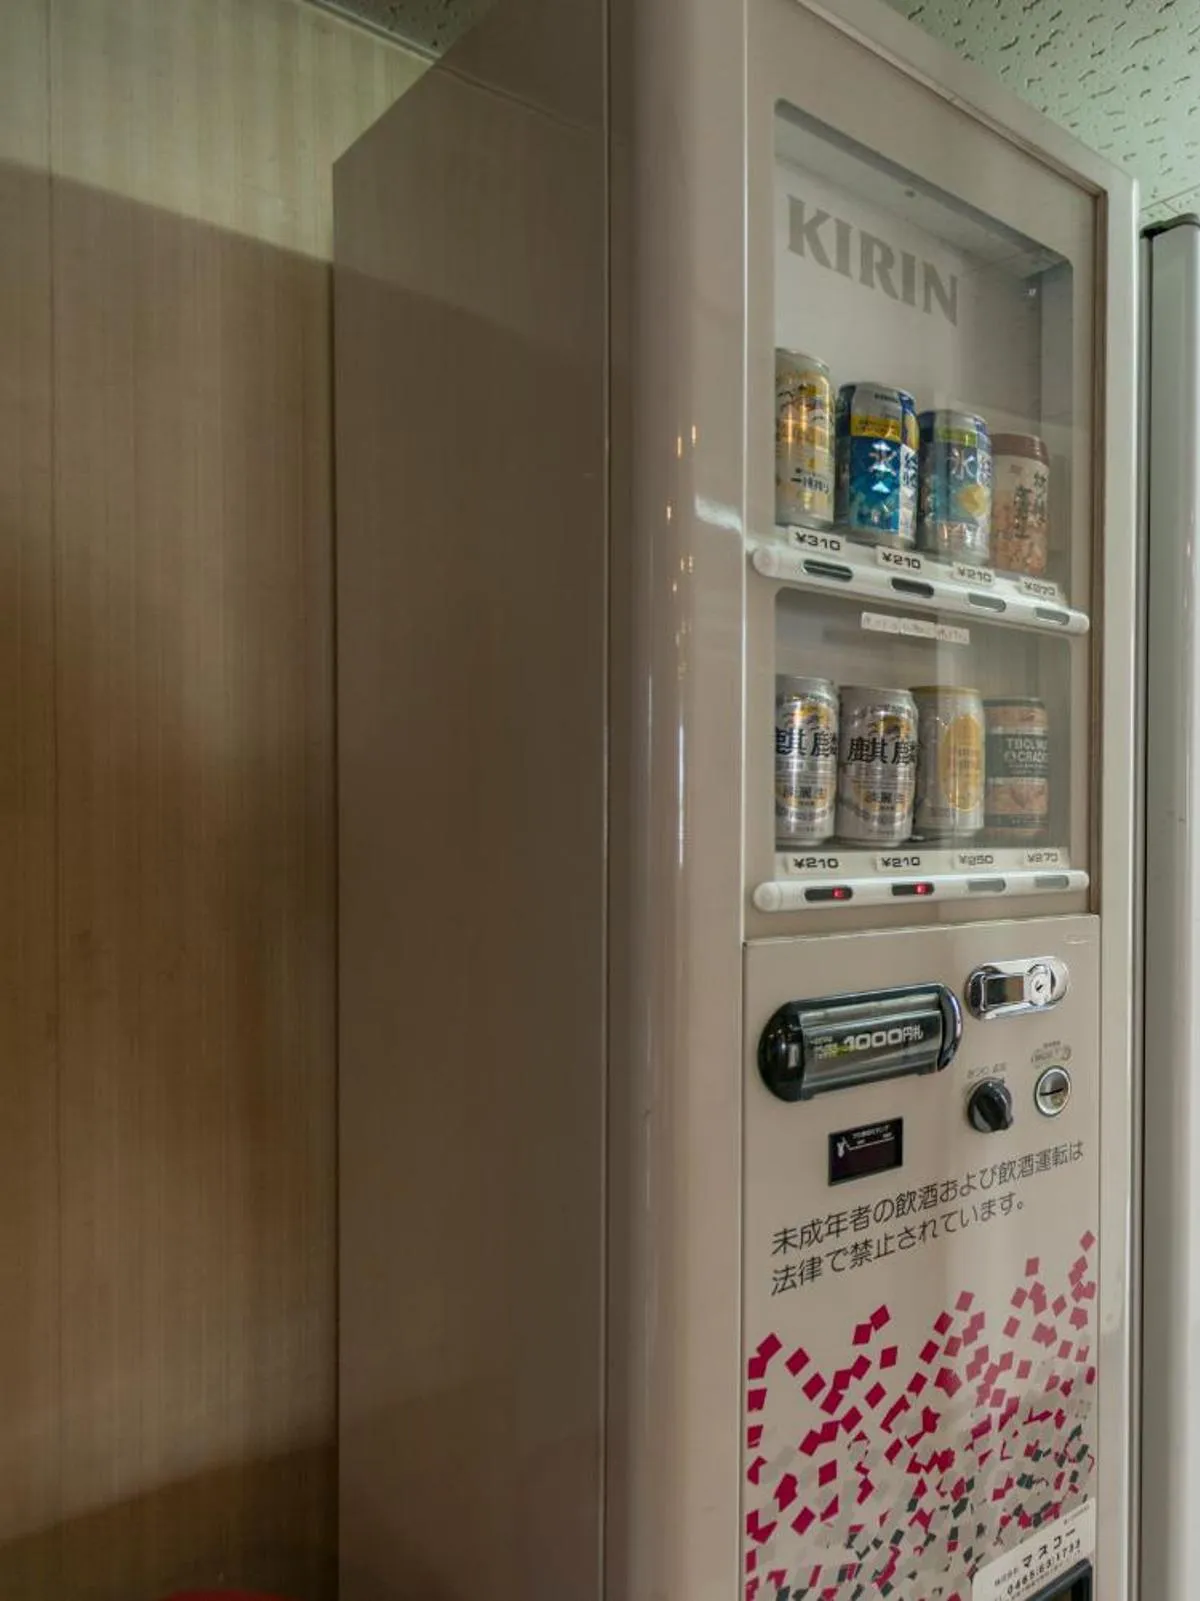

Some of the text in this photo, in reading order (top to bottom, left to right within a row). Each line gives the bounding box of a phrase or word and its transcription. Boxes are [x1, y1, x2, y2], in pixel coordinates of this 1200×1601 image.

[785, 194, 960, 327] KIRIN
[795, 530, 841, 551] ¥310
[882, 551, 921, 570] ¥210
[793, 856, 840, 870] ¥210
[881, 855, 921, 868] ¥210
[771, 1140, 1085, 1255] 未成年者の飲酒および飲酒運転は
[771, 1190, 1025, 1297] 法律で禁止されています。
